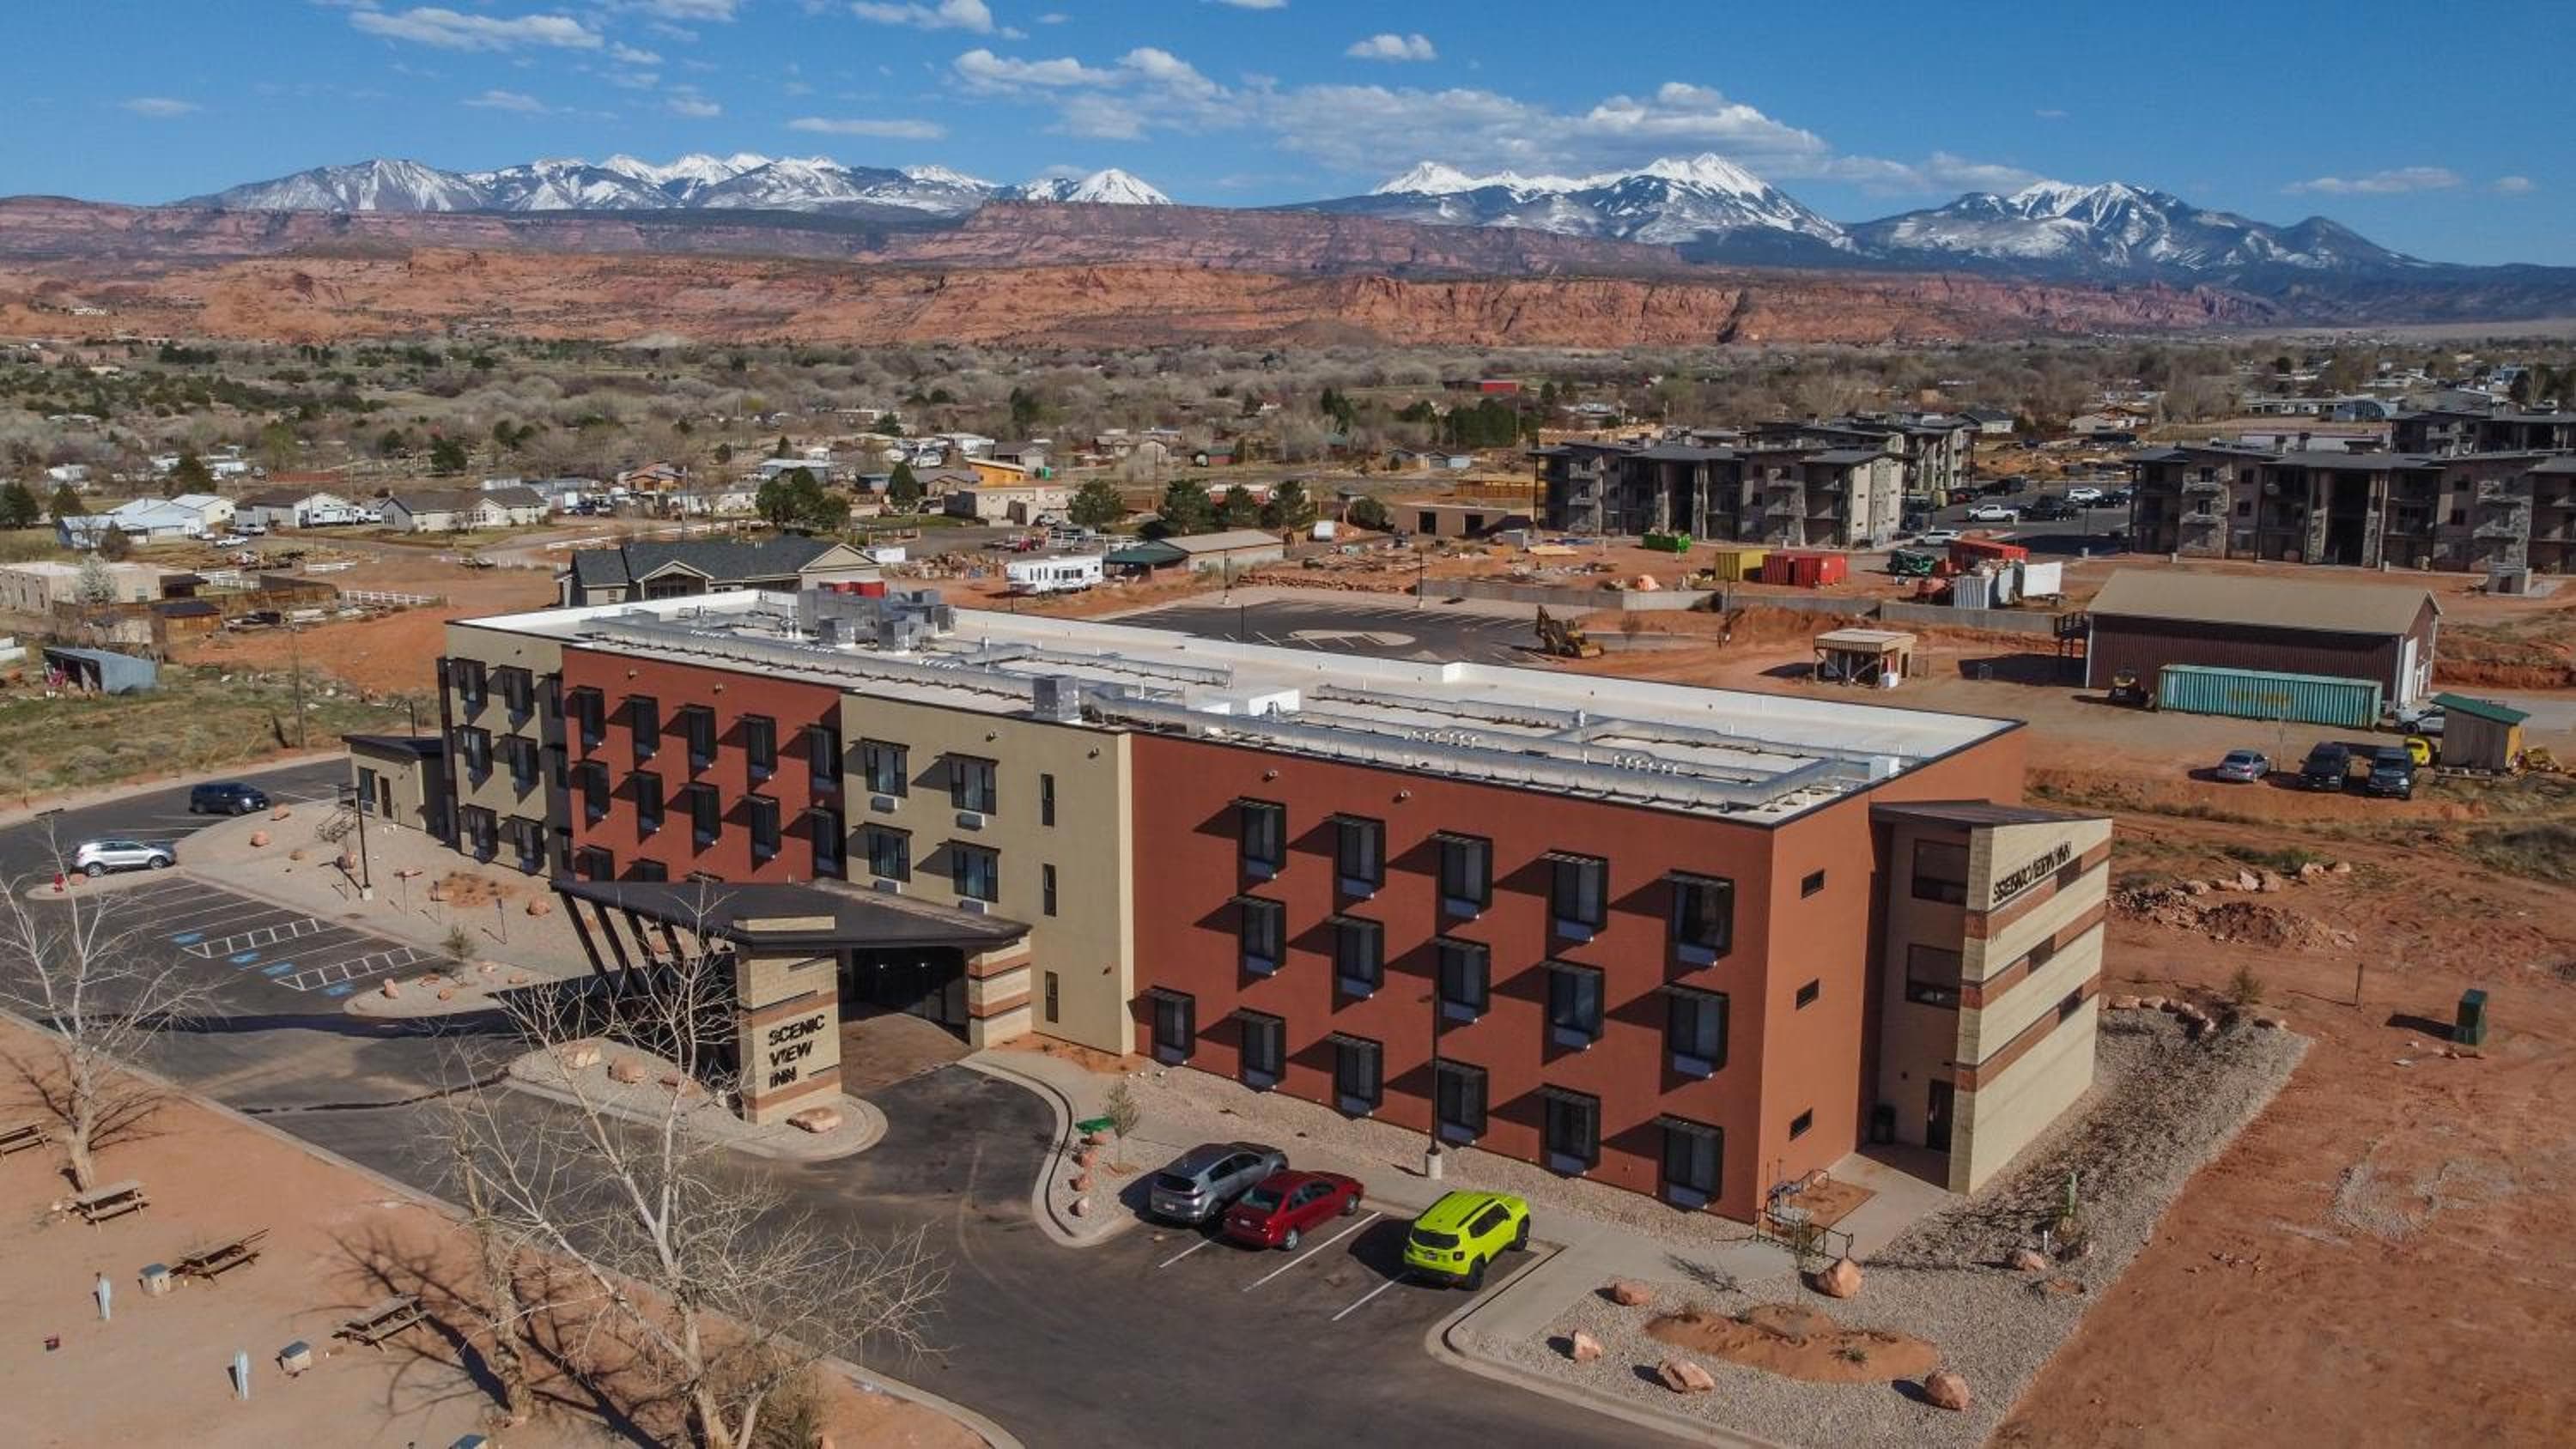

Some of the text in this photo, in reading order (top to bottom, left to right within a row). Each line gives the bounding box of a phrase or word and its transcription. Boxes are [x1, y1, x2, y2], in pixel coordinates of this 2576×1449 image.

[769, 1015, 825, 1046] SCENIC
[769, 1040, 814, 1067] VIEW
[769, 1066, 797, 1088] INN
